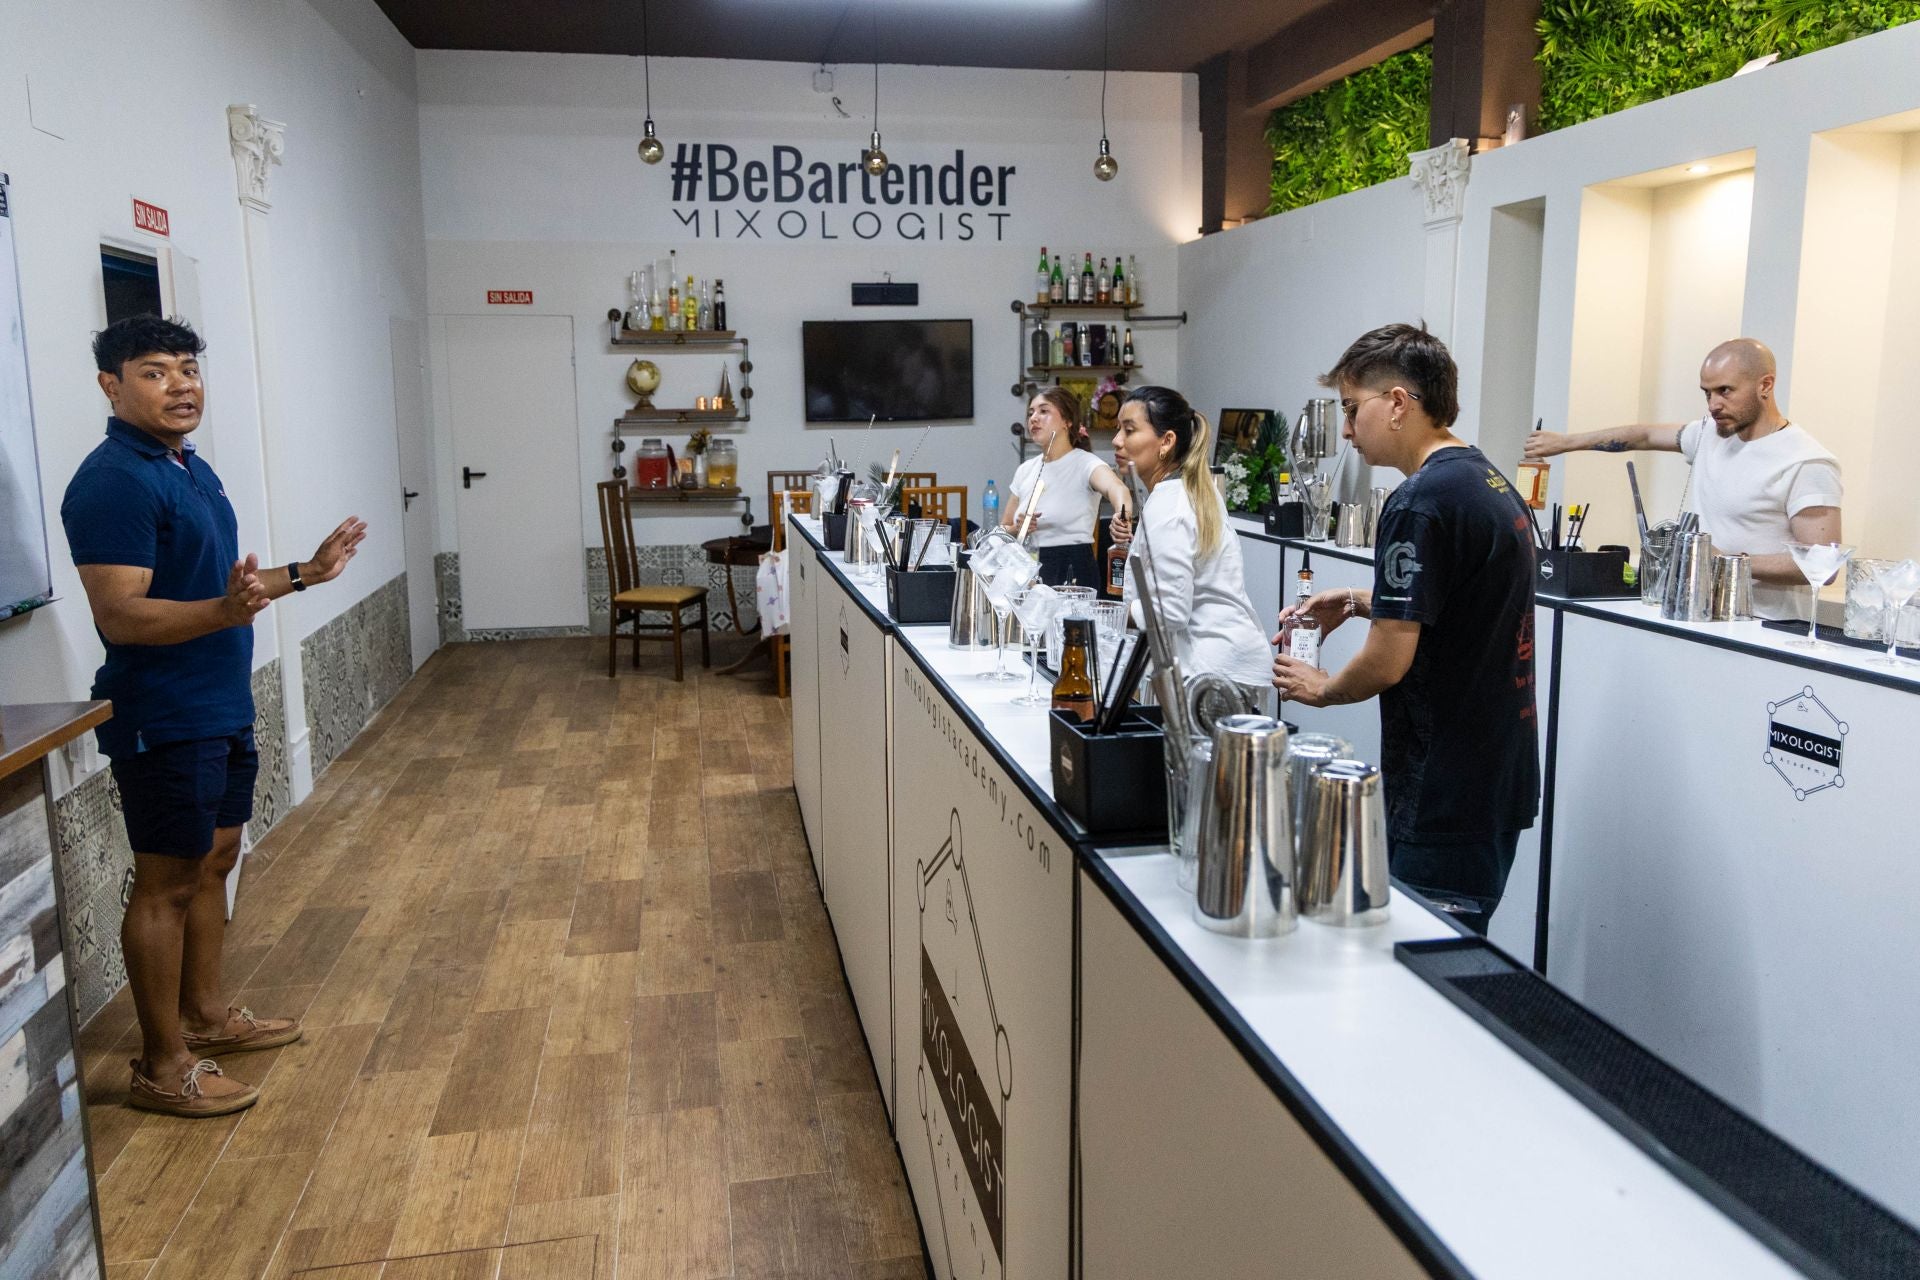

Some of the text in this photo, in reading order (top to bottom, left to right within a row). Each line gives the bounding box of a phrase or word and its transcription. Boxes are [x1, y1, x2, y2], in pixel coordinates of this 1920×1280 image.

[671, 143, 1015, 206] #BeBartender
[136, 202, 168, 233] SIN SALIDA
[672, 208, 1011, 241] MIXOLOGIST
[489, 291, 531, 303] SIN SALIDA
[1769, 730, 1842, 761] MIXOLOGIST
[904, 667, 1050, 874] mixologistacademy.com
[922, 986, 1004, 1219] MIXOLOGIST
